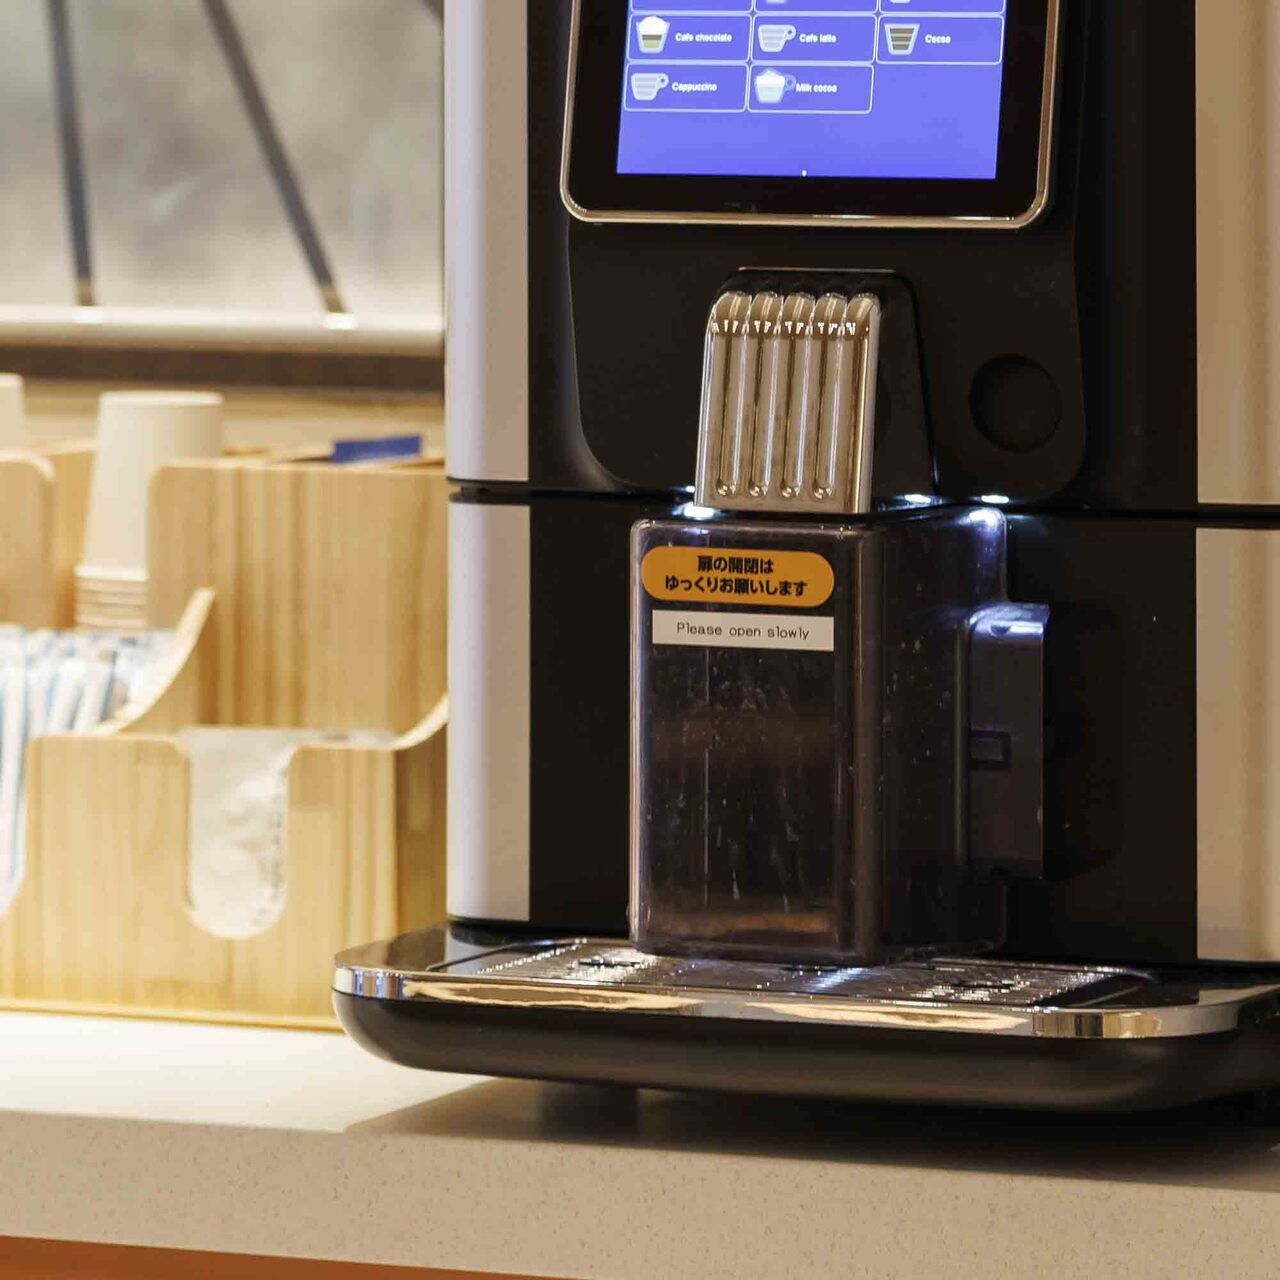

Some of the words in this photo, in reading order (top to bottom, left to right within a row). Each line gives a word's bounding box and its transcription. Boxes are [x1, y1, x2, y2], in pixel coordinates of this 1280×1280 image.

[925, 34, 951, 44] Cocoa
[672, 82, 717, 93] Cappuccino
[796, 83, 812, 93] Milk
[813, 83, 837, 93] cocoa
[697, 555, 774, 575] 扉の開閉は
[665, 574, 808, 597] ゆっくりお願いします
[676, 621, 722, 636] Please
[729, 626, 762, 638] open
[767, 625, 810, 641] slowly
